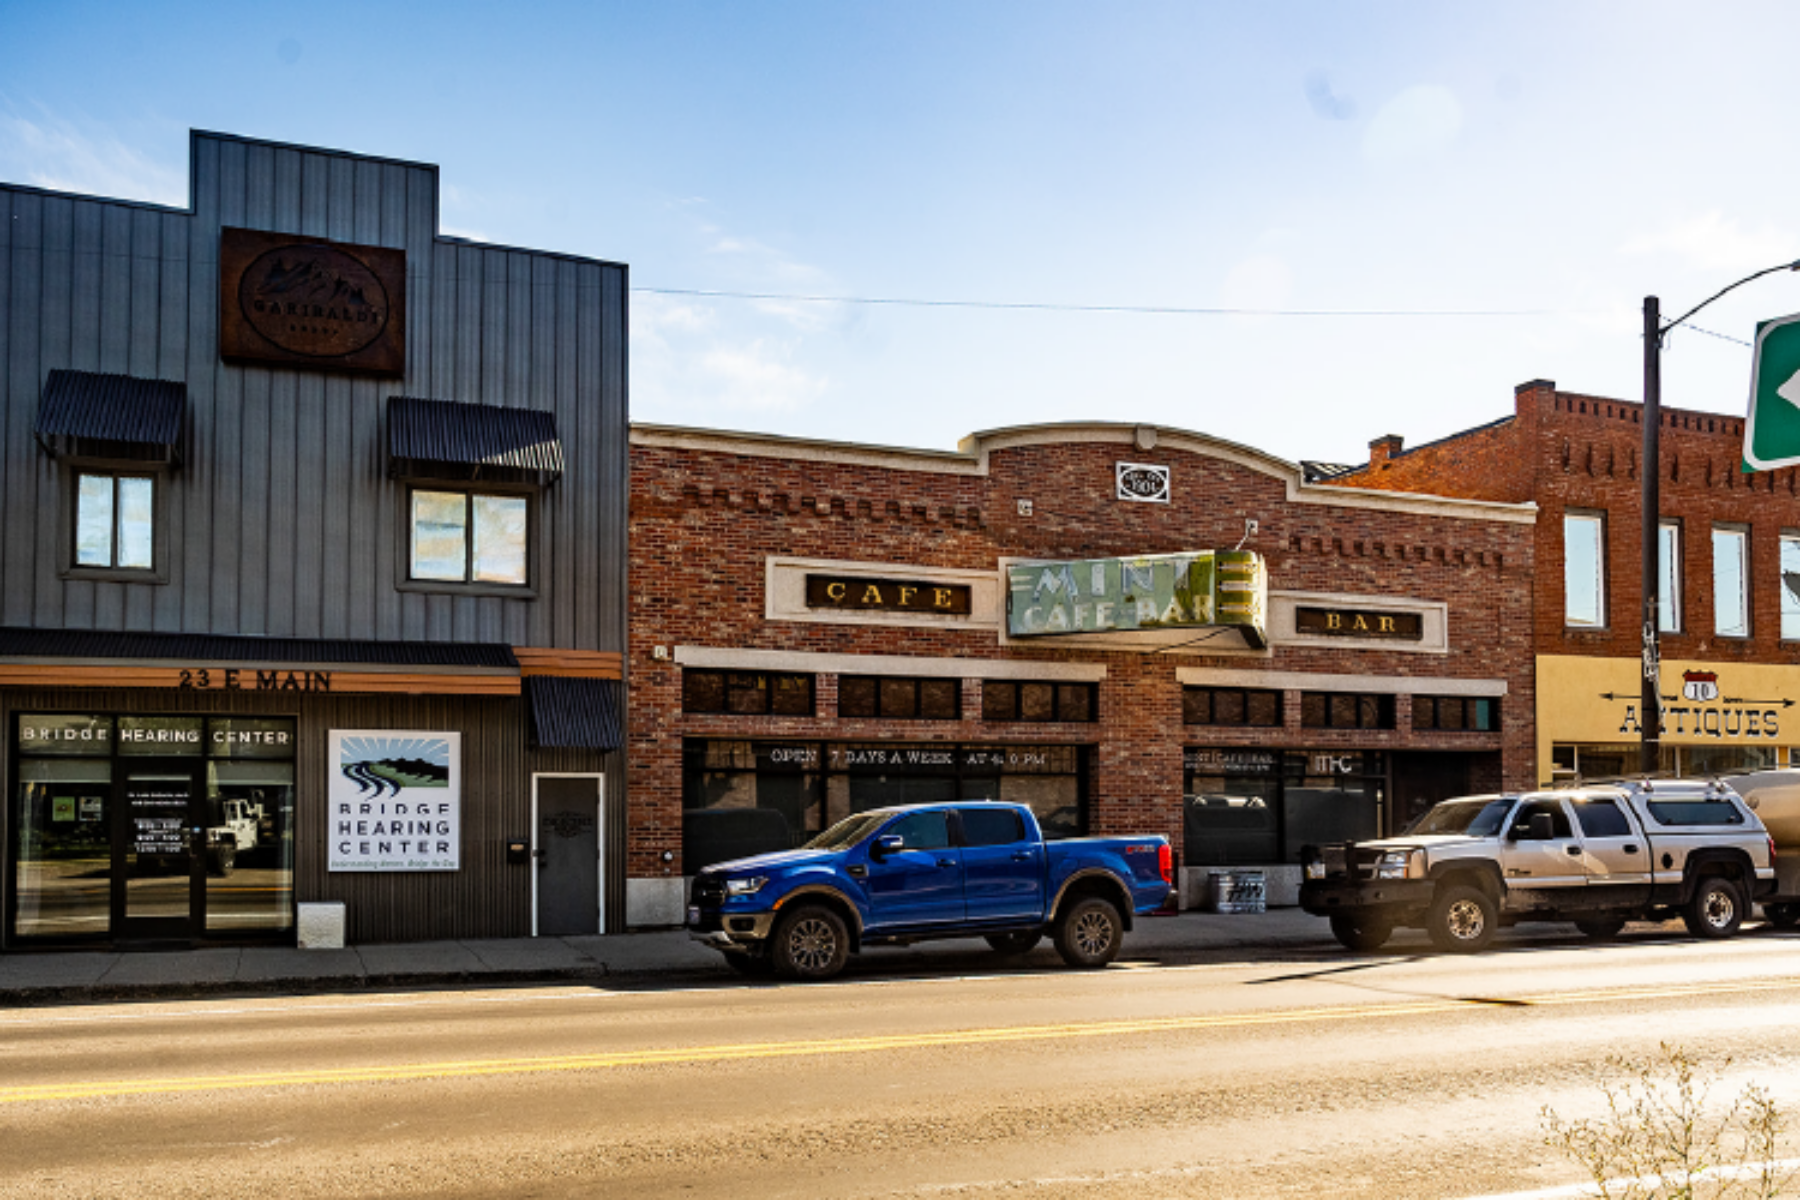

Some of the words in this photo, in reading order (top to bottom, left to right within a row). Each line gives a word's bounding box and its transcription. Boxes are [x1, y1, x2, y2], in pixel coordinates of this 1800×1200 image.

[826, 582, 952, 607] CAFE
[1326, 613, 1396, 632] BAR
[180, 669, 209, 689] 23
[225, 669, 240, 690] E
[257, 670, 331, 692] MAIN
[1692, 683, 1710, 700] 10
[23, 727, 108, 742] BRIDGE
[121, 728, 199, 743] HEARING
[213, 730, 289, 745] CENTER
[770, 748, 817, 763] OPEN
[845, 750, 886, 764] DAYS
[906, 750, 953, 764] WEEK
[338, 803, 450, 815] BRIDGE
[338, 820, 450, 836] HEARING
[338, 841, 450, 855] CENTER
